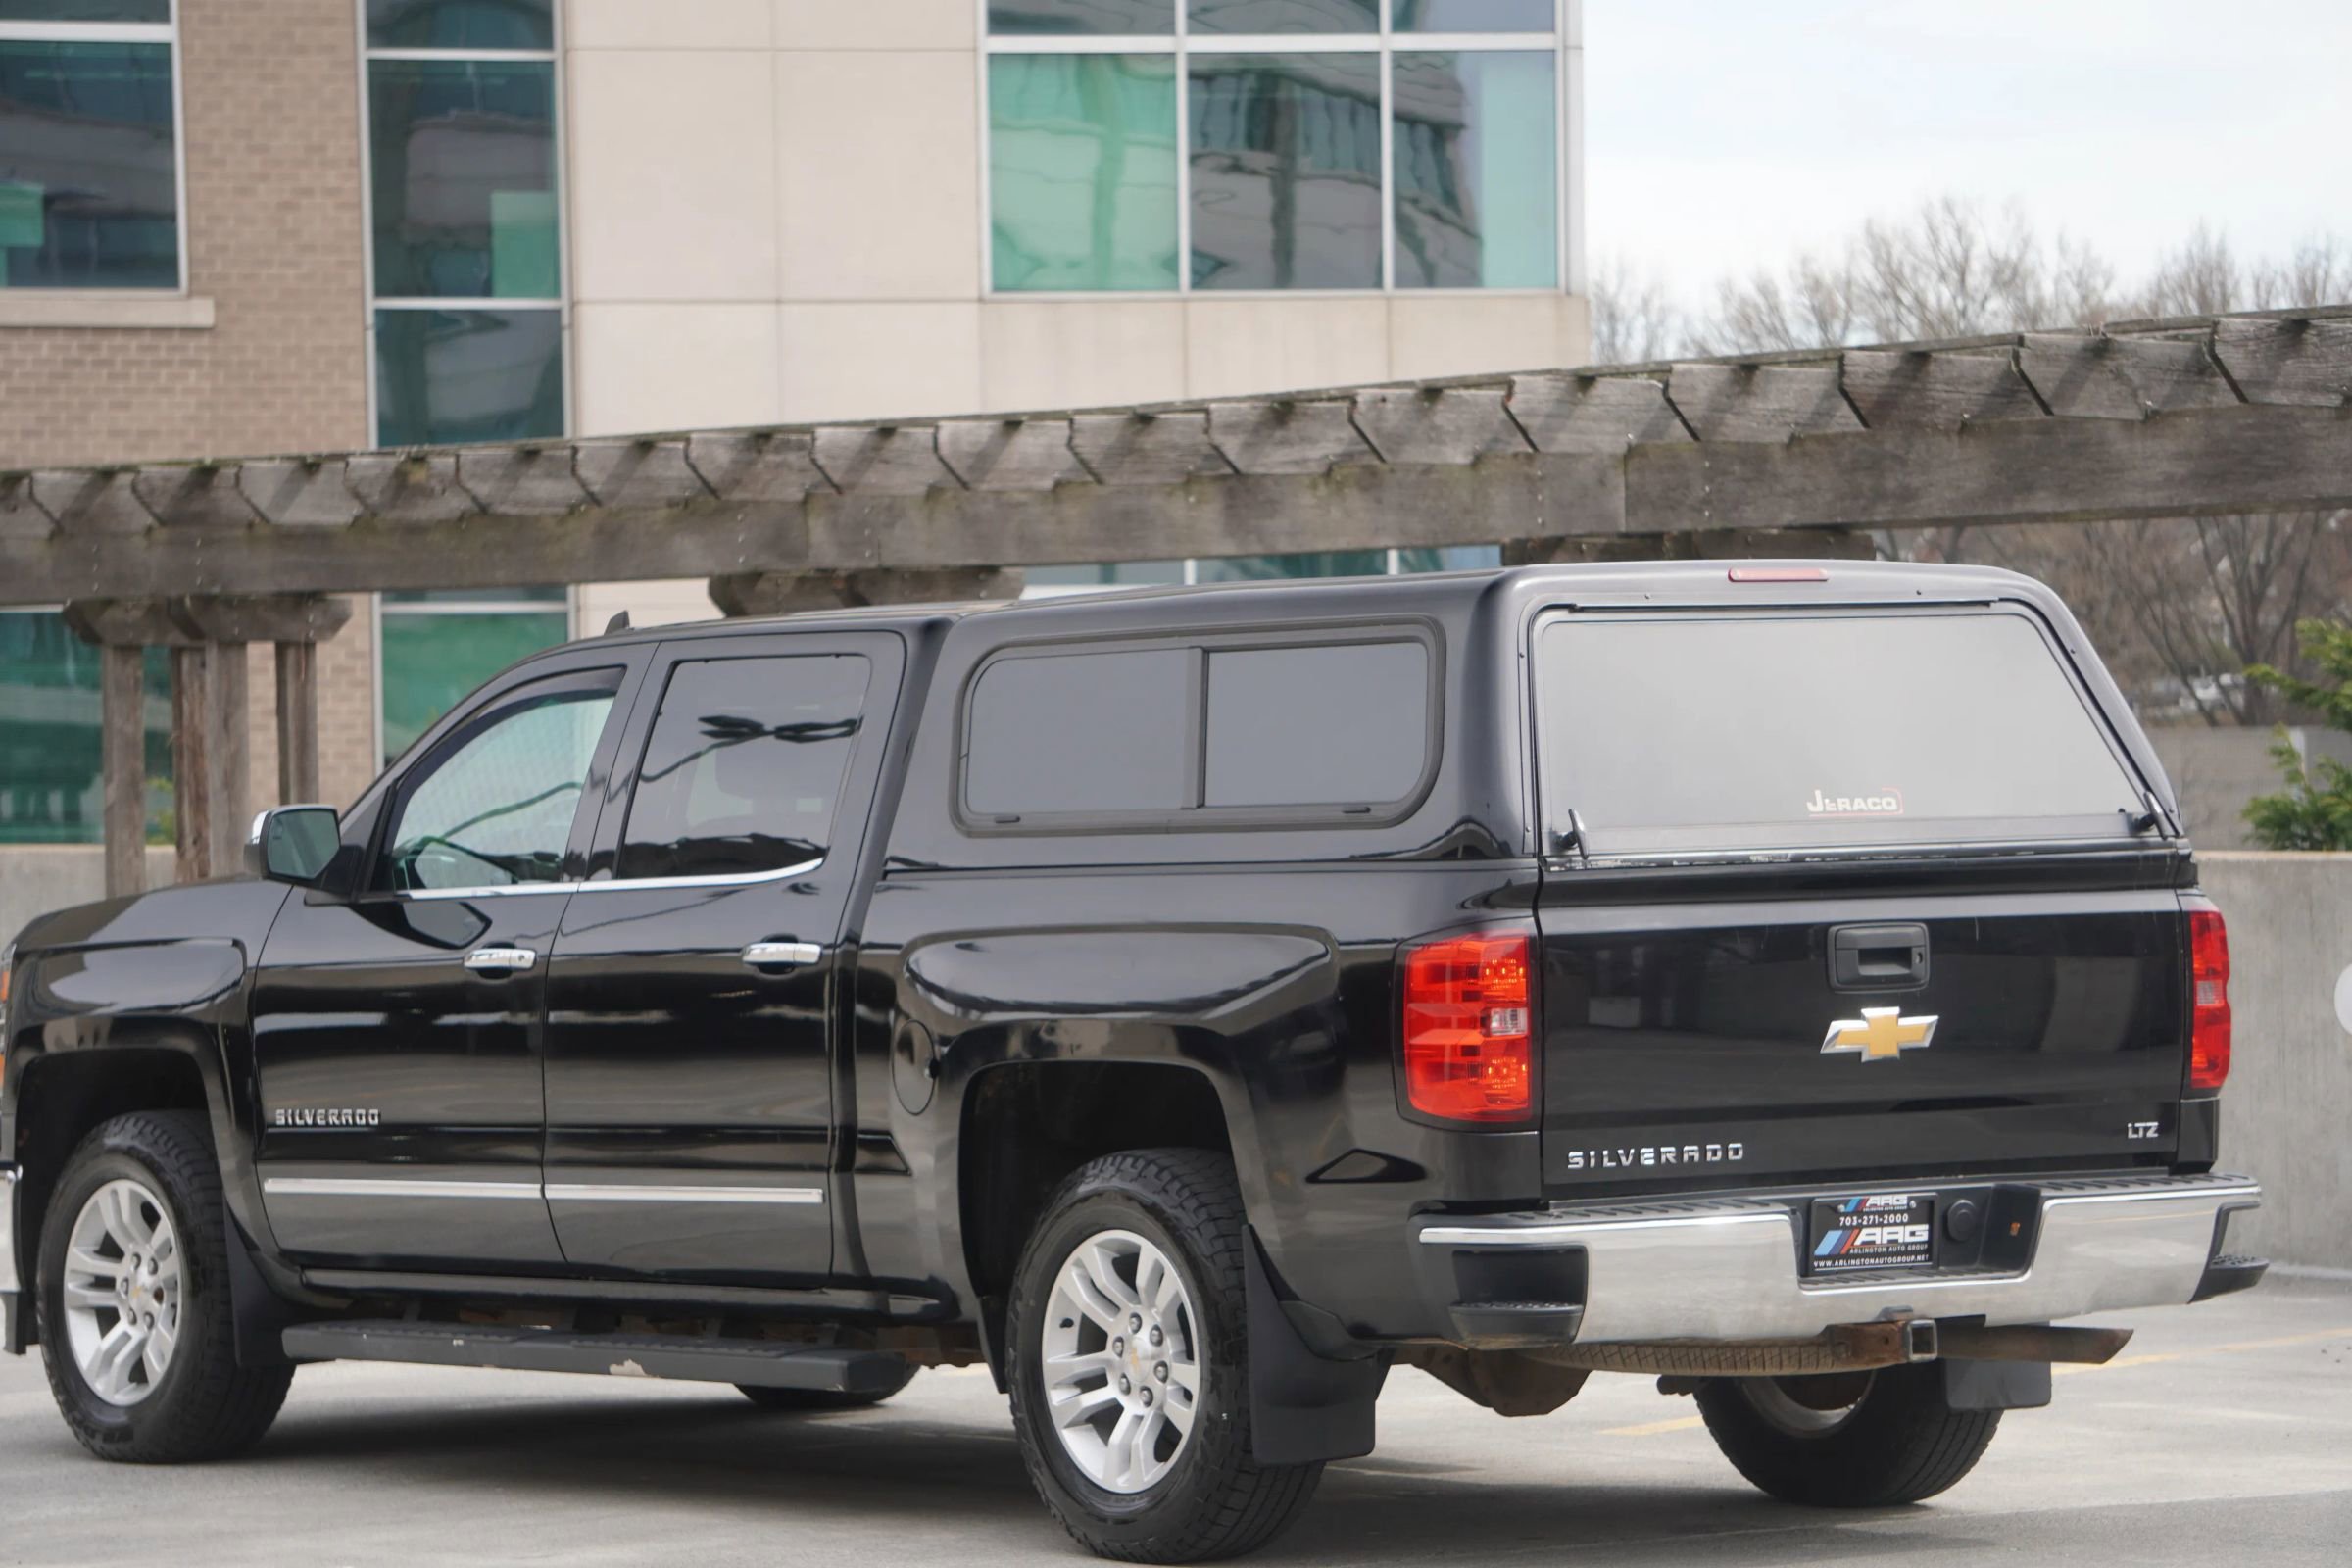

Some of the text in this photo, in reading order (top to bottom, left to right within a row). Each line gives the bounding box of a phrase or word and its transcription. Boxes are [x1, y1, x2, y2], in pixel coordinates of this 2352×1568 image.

[1806, 789, 1898, 812] JERACO
[275, 1108, 379, 1126] SILVERADO
[2127, 1121, 2159, 1139] LTZ
[1568, 1143, 1743, 1169] SILVERADO
[1866, 1195, 1908, 1206] AAG
[1853, 1224, 1929, 1246] AAG
[1849, 1243, 1929, 1254] ARLINGTON AUTO GROUP
